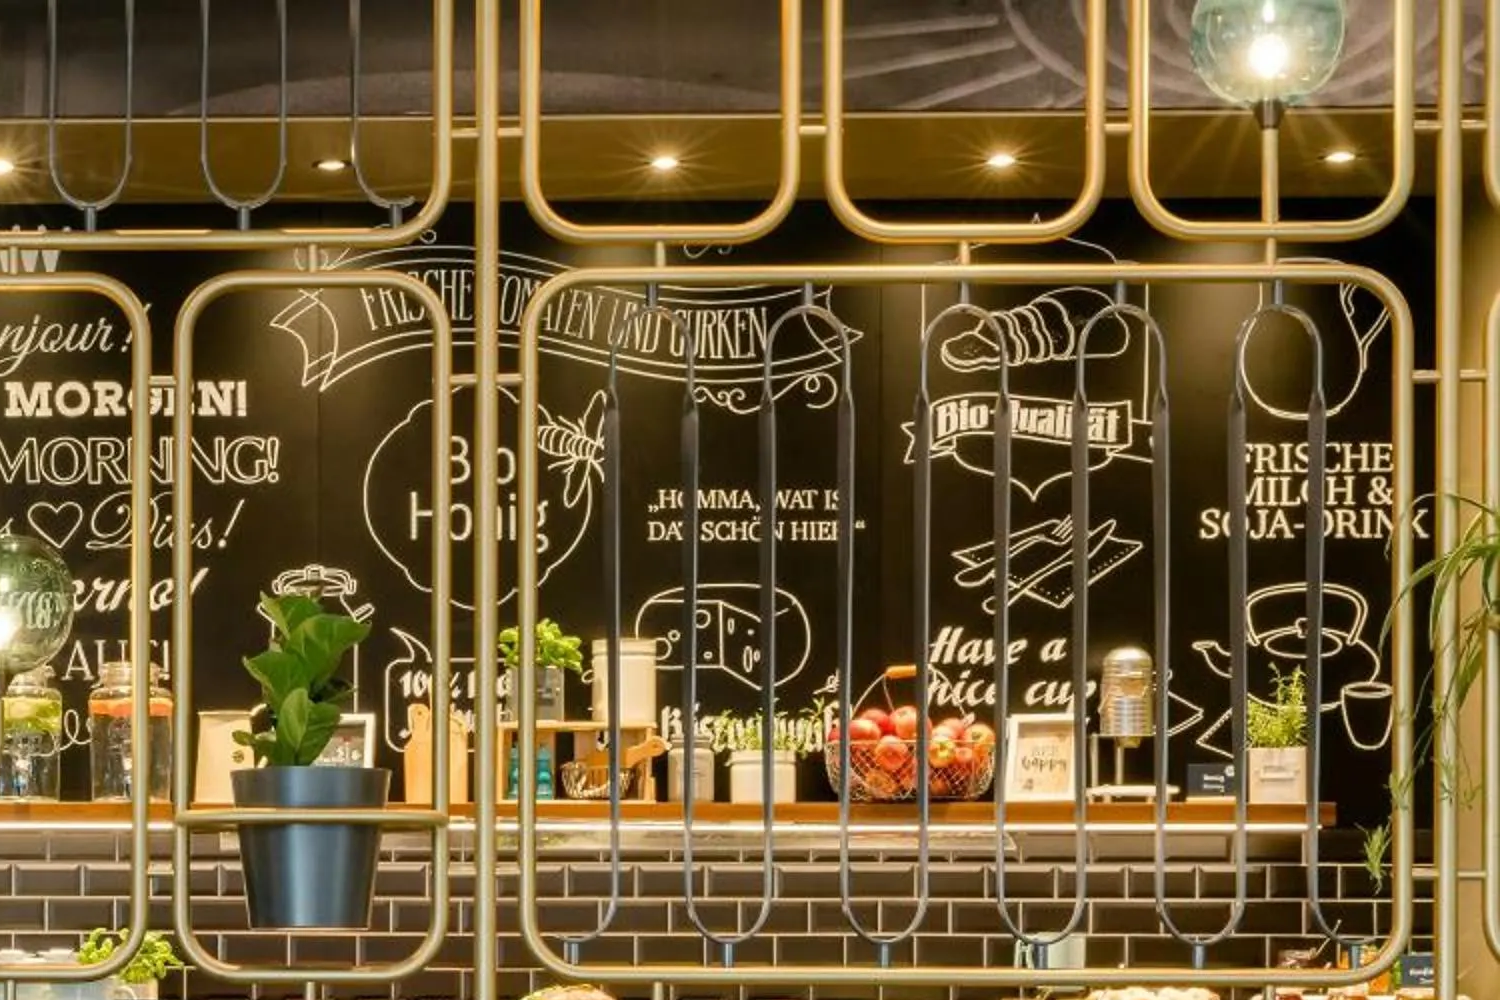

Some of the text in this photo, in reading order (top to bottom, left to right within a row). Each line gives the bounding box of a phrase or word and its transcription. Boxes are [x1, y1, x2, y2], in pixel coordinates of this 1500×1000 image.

[936, 399, 1122, 444] Bio-ualiät
[451, 435, 517, 485] Bo
[1367, 475, 1394, 505] &
[647, 520, 684, 541] DA
[929, 626, 1068, 667] Have a
